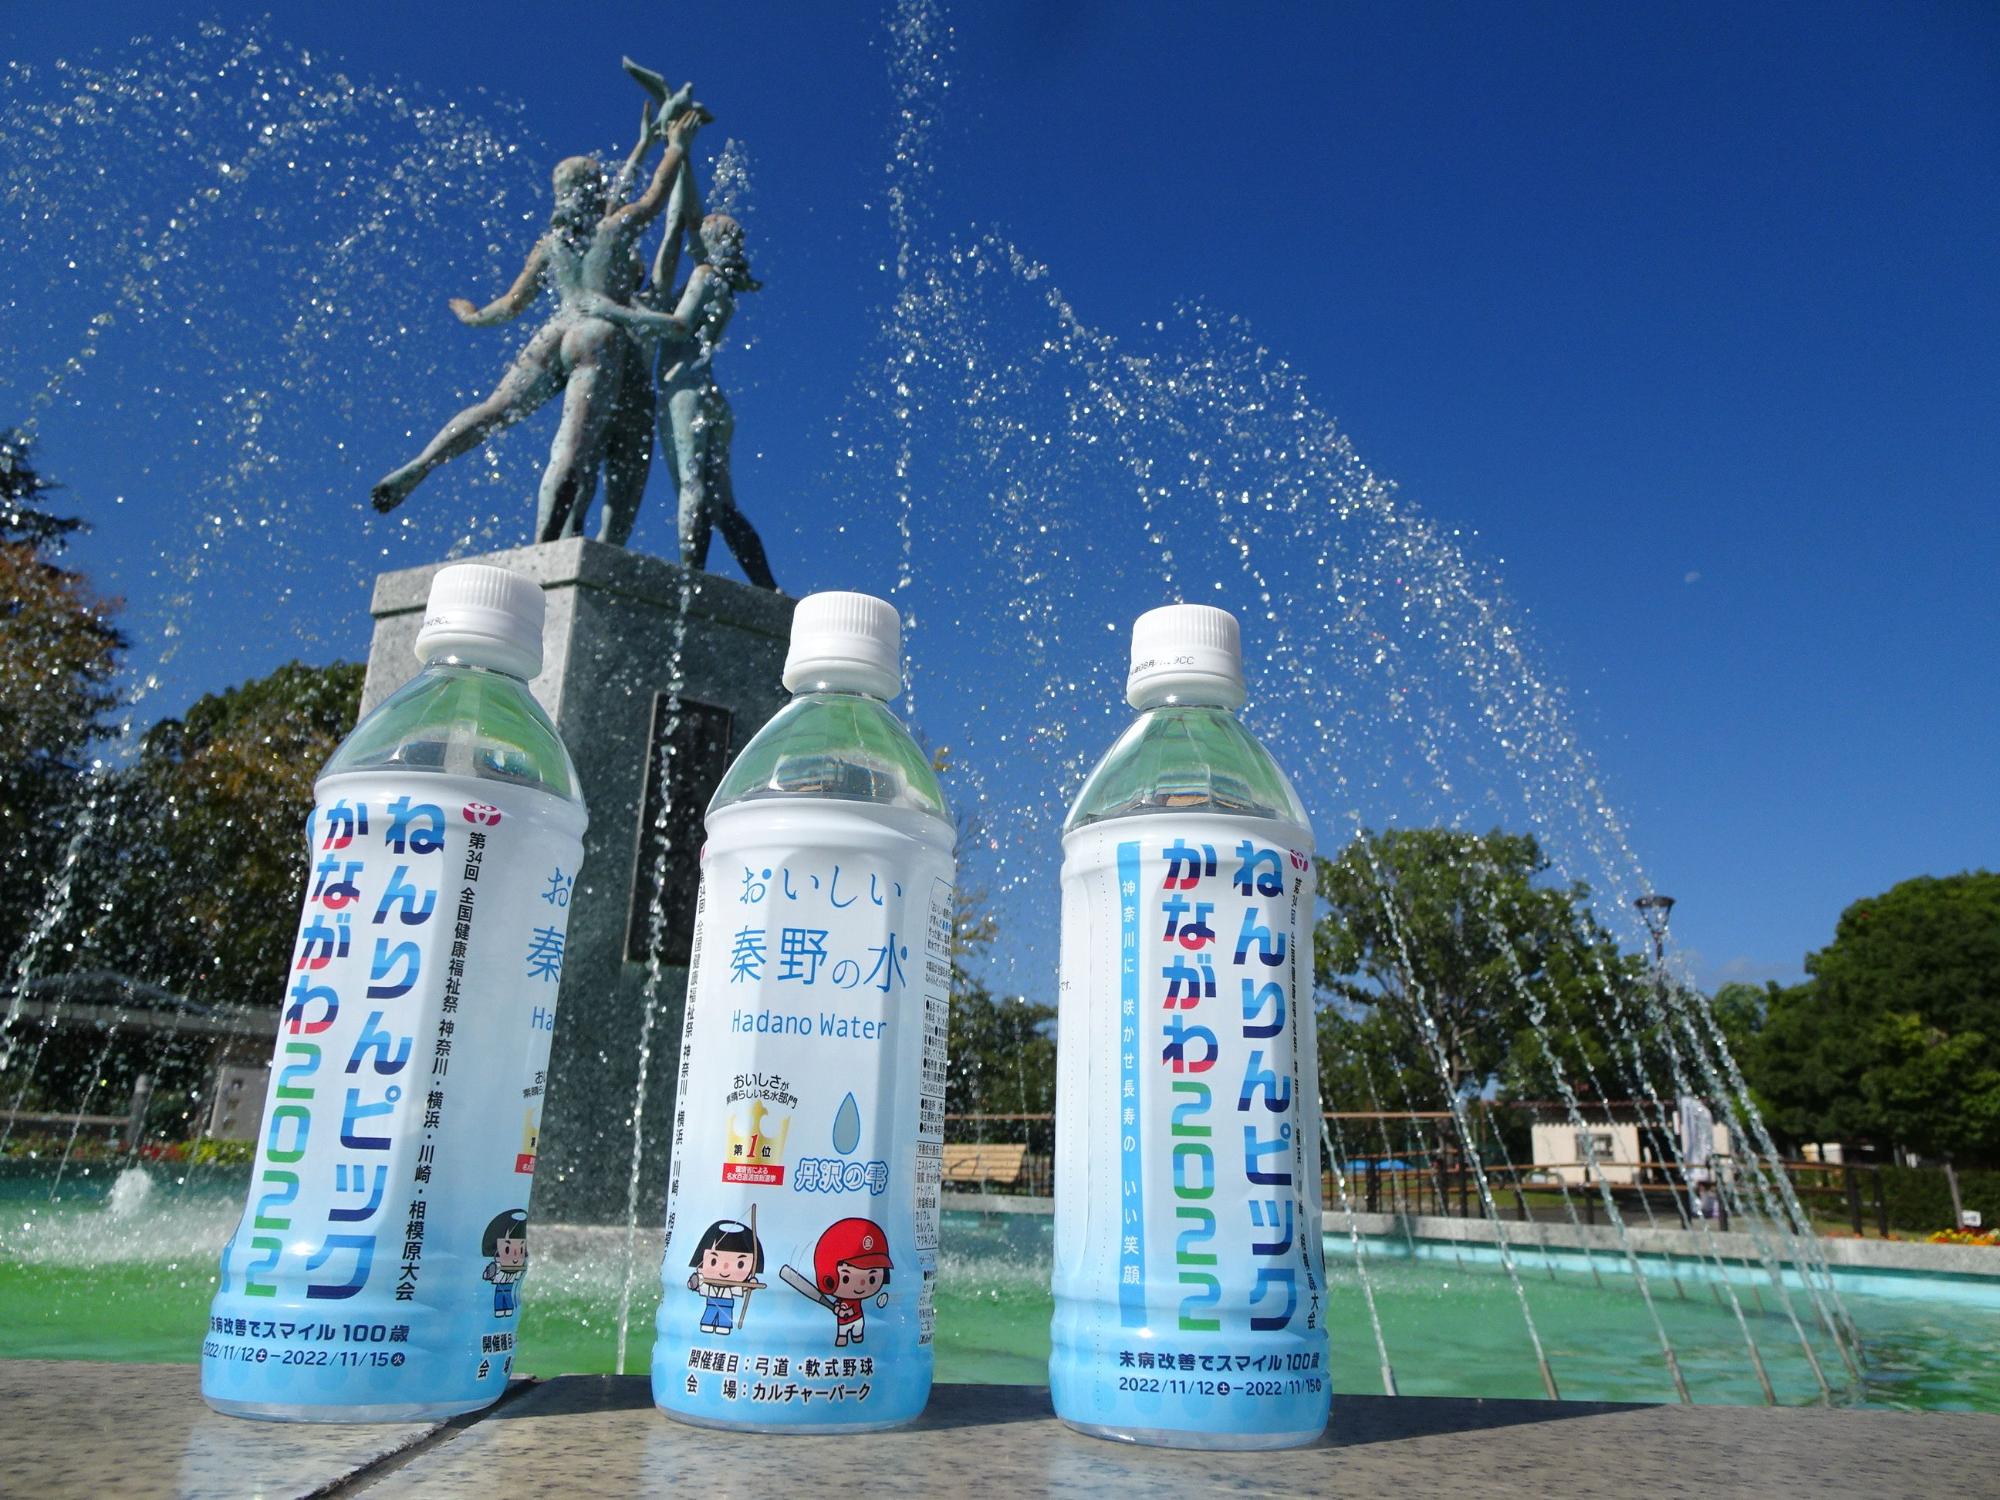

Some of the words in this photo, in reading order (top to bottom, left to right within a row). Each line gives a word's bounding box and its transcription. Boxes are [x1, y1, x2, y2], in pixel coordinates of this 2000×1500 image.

[463, 832, 486, 882] 第34回
[739, 865, 902, 908] おいしい
[442, 887, 476, 1013] 全国健康福祉祭
[730, 925, 908, 993] 秦野の水
[1121, 880, 1137, 974] 神奈川に
[244, 798, 368, 1298] かながわ2022
[306, 796, 446, 1300] ねんりんピック
[731, 1009, 812, 1035] Hadano
[820, 1013, 888, 1040] Water
[733, 1072, 790, 1092] おいしさが
[1121, 998, 1137, 1152] 咲かせ長寿の
[1162, 838, 1221, 1332] かながわ2022
[1233, 840, 1299, 1331] ねんりんピック
[794, 1158, 889, 1196] 丹沢の雫
[1123, 1181, 1140, 1285] いい笑顔
